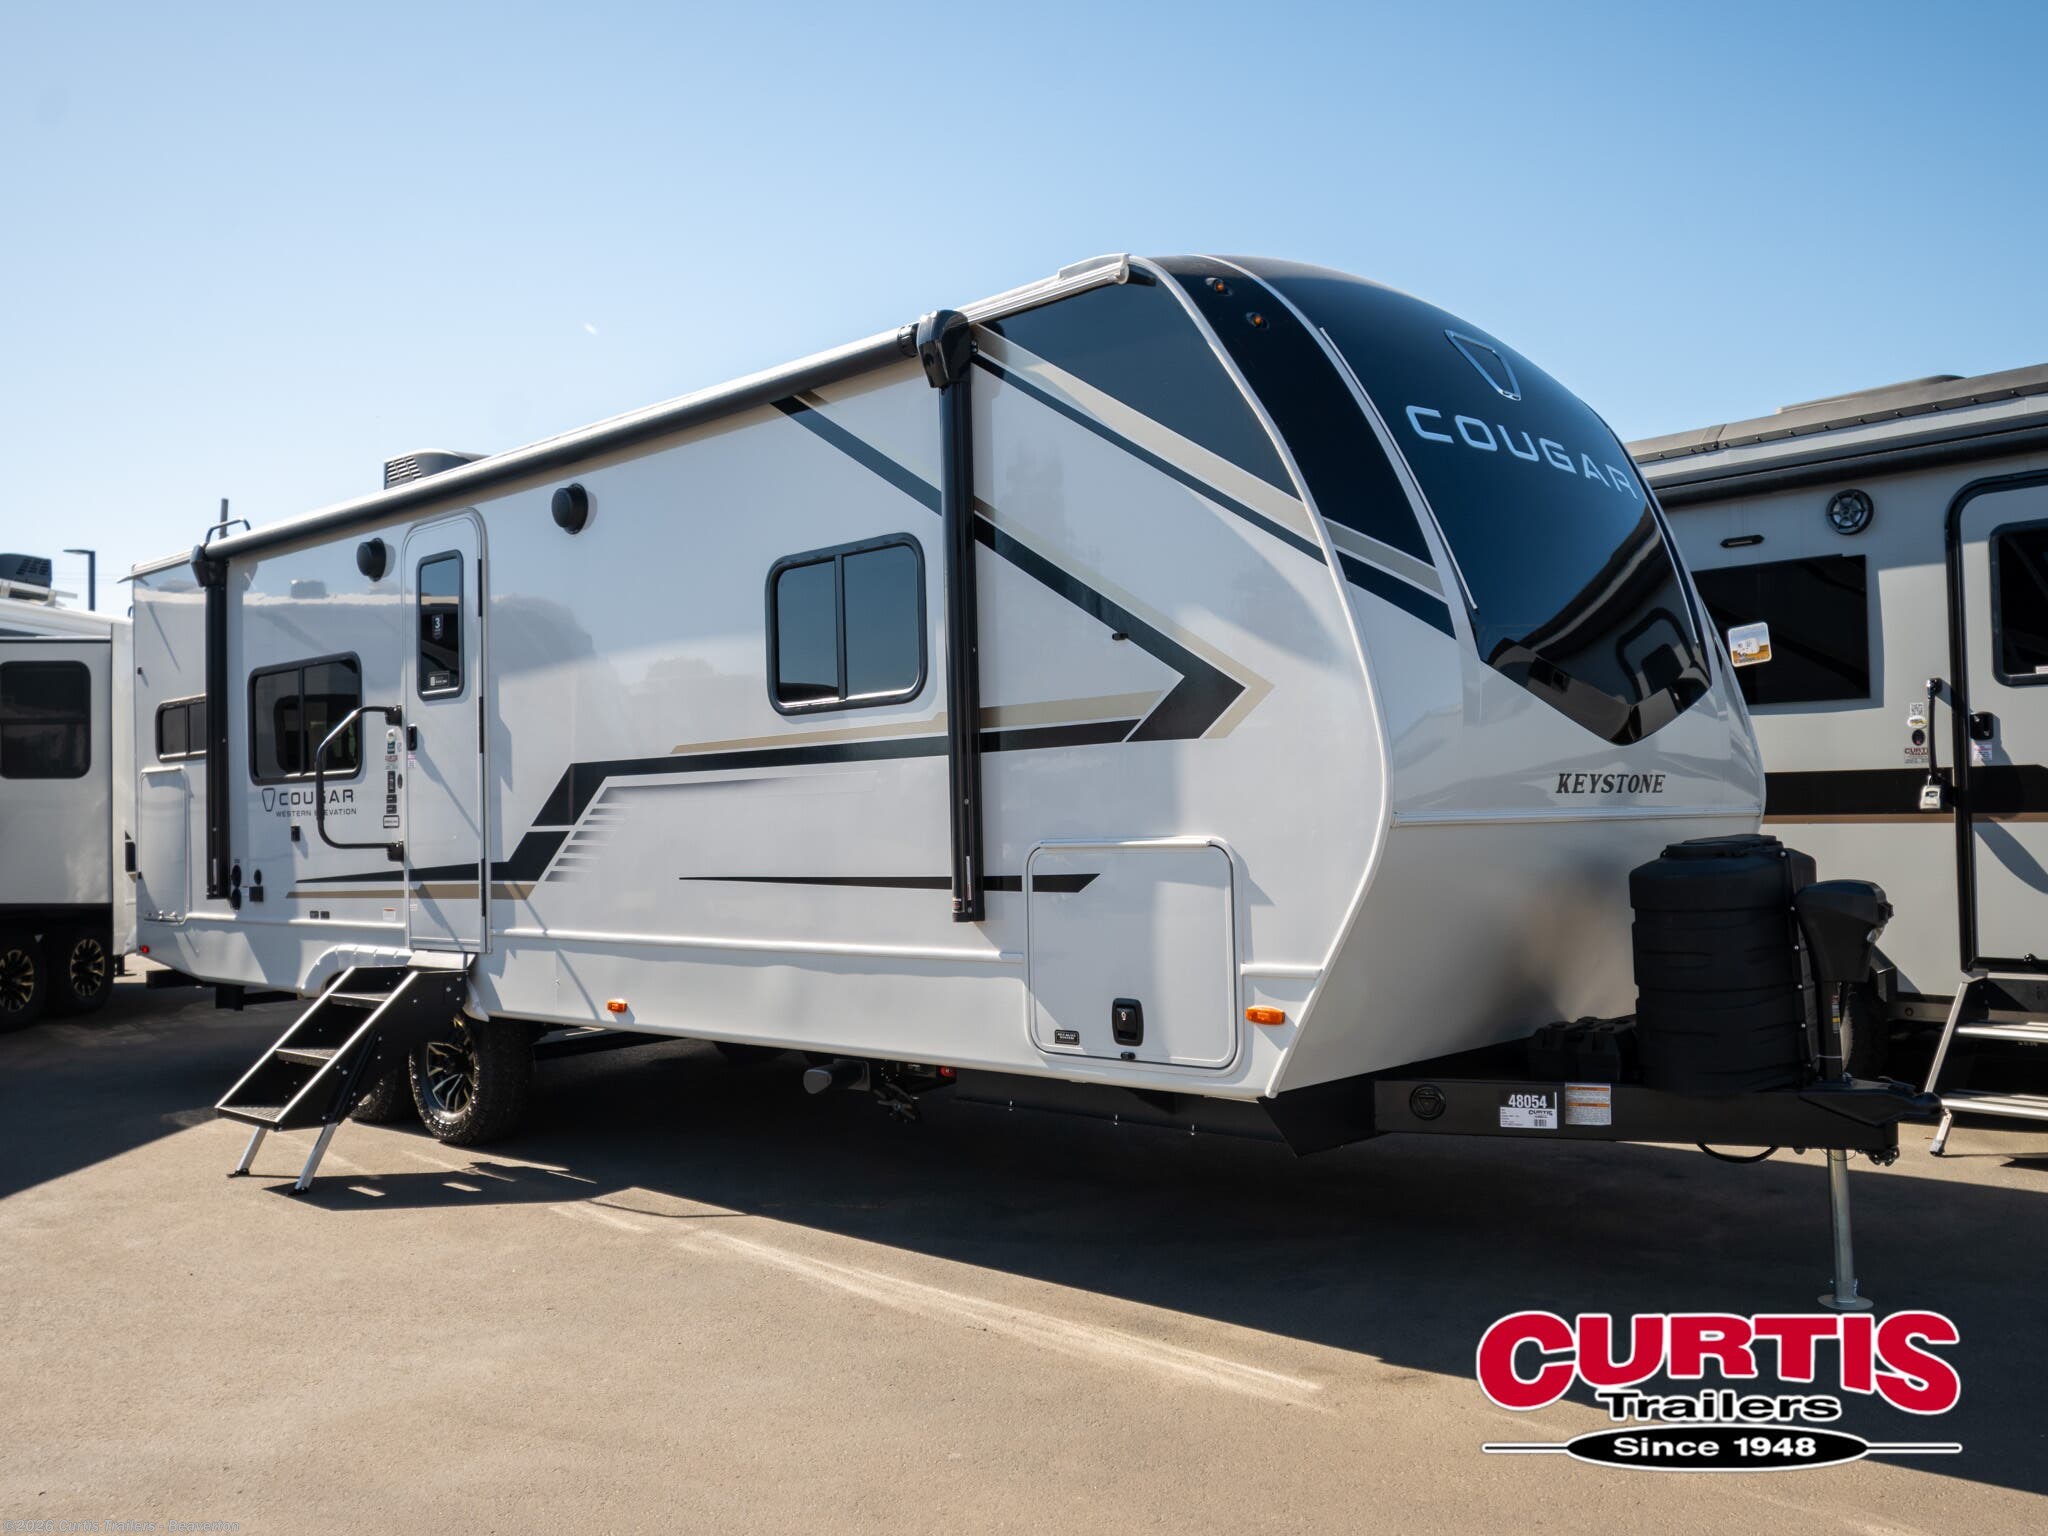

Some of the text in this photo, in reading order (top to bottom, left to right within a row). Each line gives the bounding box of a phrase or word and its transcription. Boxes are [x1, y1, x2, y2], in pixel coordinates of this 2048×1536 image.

[1405, 404, 1639, 500] COUGAR
[1555, 773, 1666, 794] KEYSTONE
[275, 809, 312, 817] WESTERN
[1508, 1094, 1547, 1109] 48054
